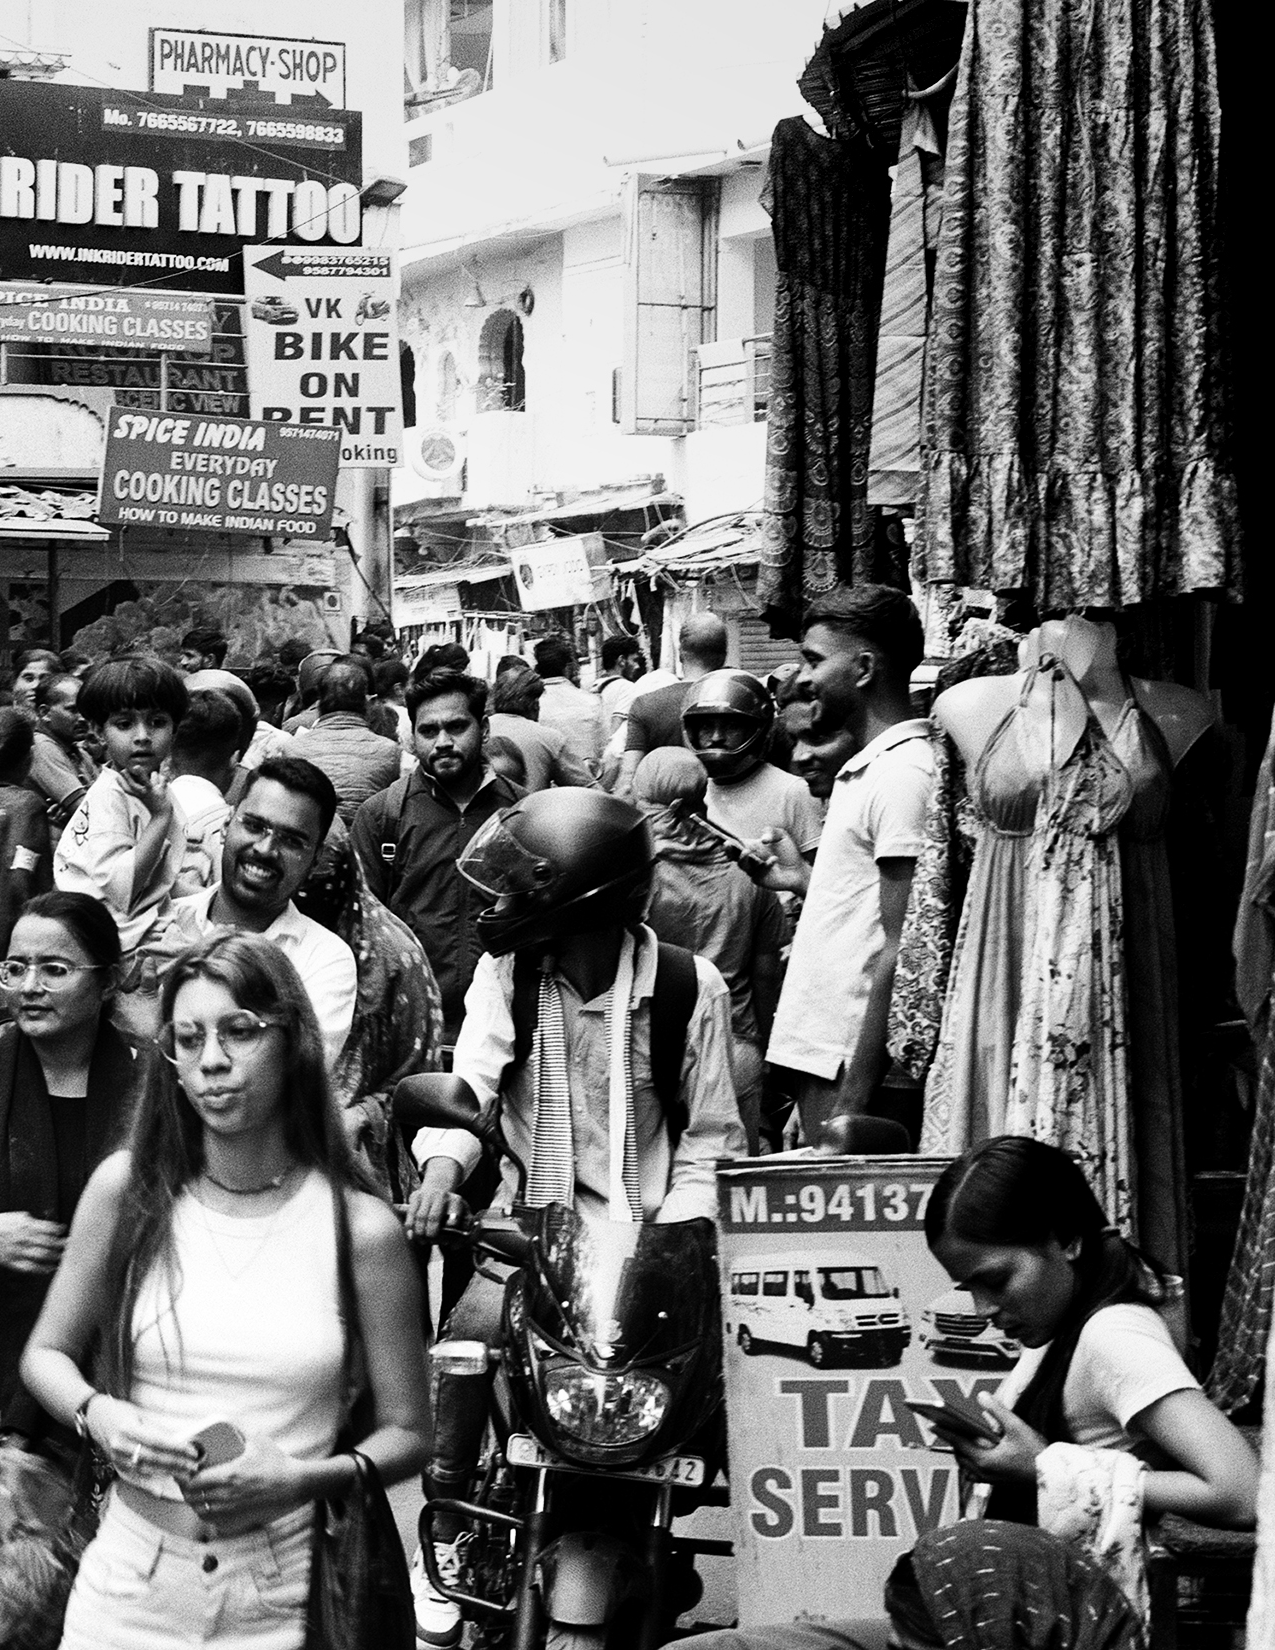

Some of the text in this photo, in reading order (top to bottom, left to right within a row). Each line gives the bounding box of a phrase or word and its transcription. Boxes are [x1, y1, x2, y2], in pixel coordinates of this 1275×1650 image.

[159, 38, 337, 83] PHARMACY-SHOP
[173, 169, 362, 244] TATTOO
[29, 243, 230, 272] WWW.INKRIDERTATTOO.COM
[58, 297, 131, 314] INDIA
[305, 298, 342, 319] VK
[27, 310, 118, 337] COOKING
[124, 317, 208, 341] CLASSES
[61, 337, 95, 346] MAKE
[275, 332, 390, 361] BIKE
[51, 360, 239, 392] RESTAURANT
[299, 372, 360, 399] ON
[189, 393, 241, 414] VIEW
[113, 413, 192, 443] SPICE
[193, 421, 267, 451] INDIA
[171, 451, 278, 480] EVERYDAY
[341, 444, 398, 464] oking
[113, 470, 327, 516] COOKING CLASSES
[119, 507, 317, 534] HOW TO MAKE INDIAN FOOD
[730, 1184, 929, 1223] M.:94137
[779, 1378, 1005, 1450] TAX
[750, 1467, 953, 1538] SERV
